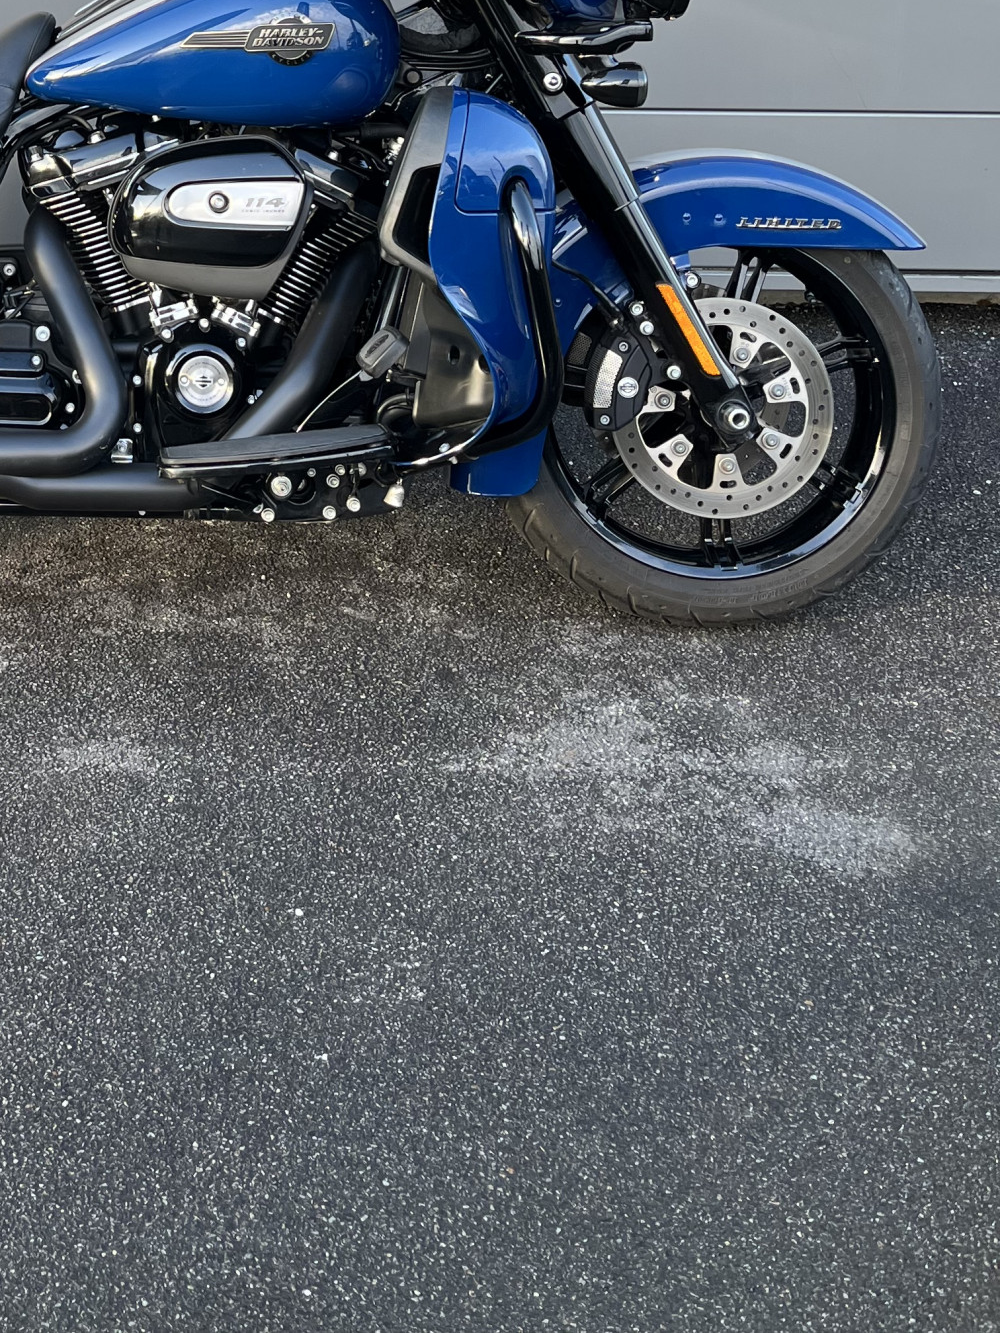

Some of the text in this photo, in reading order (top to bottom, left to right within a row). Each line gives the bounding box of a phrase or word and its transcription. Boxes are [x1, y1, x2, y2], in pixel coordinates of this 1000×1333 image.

[258, 27, 323, 38] HARLEY-
[252, 36, 324, 47] DAVIDSON
[245, 197, 285, 208] 114
[736, 216, 842, 229] LIMITED
